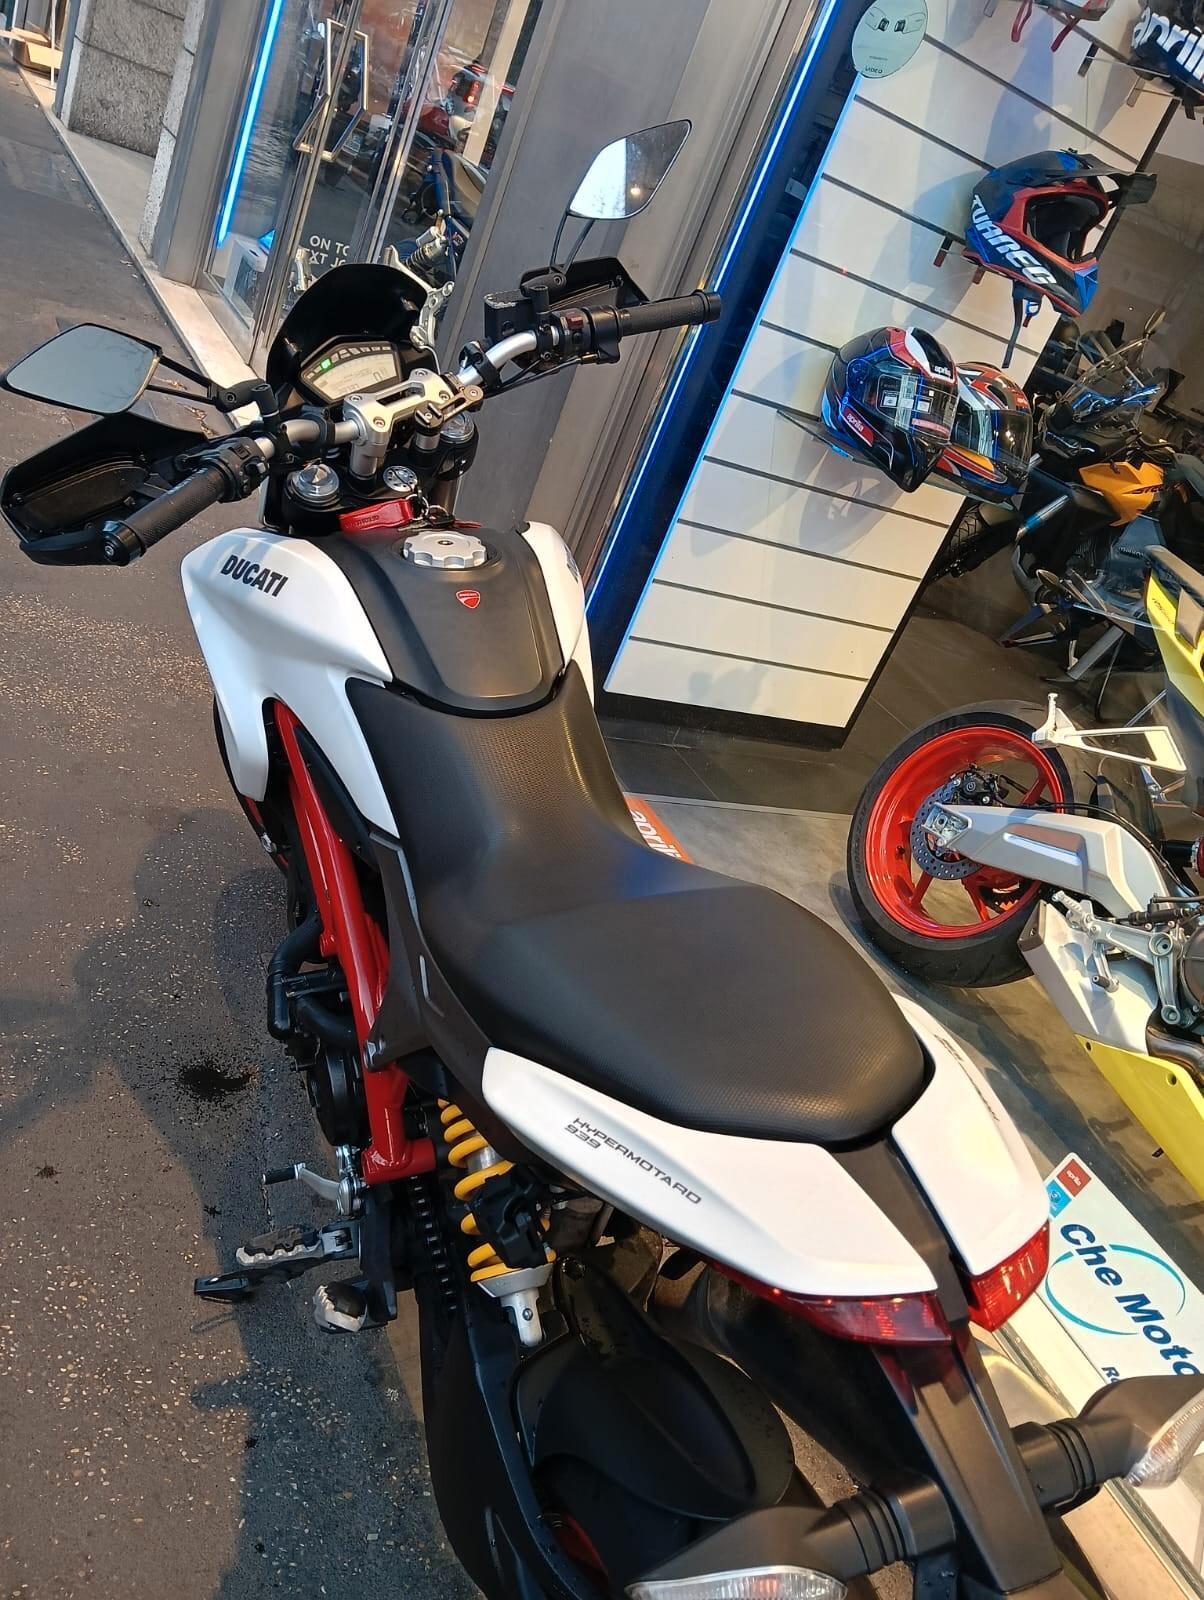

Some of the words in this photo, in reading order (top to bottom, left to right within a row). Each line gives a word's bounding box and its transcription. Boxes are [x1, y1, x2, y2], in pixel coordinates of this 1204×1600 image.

[309, 235, 331, 250] ON
[220, 554, 289, 597] DUCATI
[564, 1124, 602, 1149] 939
[573, 1117, 702, 1204] HYPERMOTARD
[1060, 1223, 1123, 1287] Che
